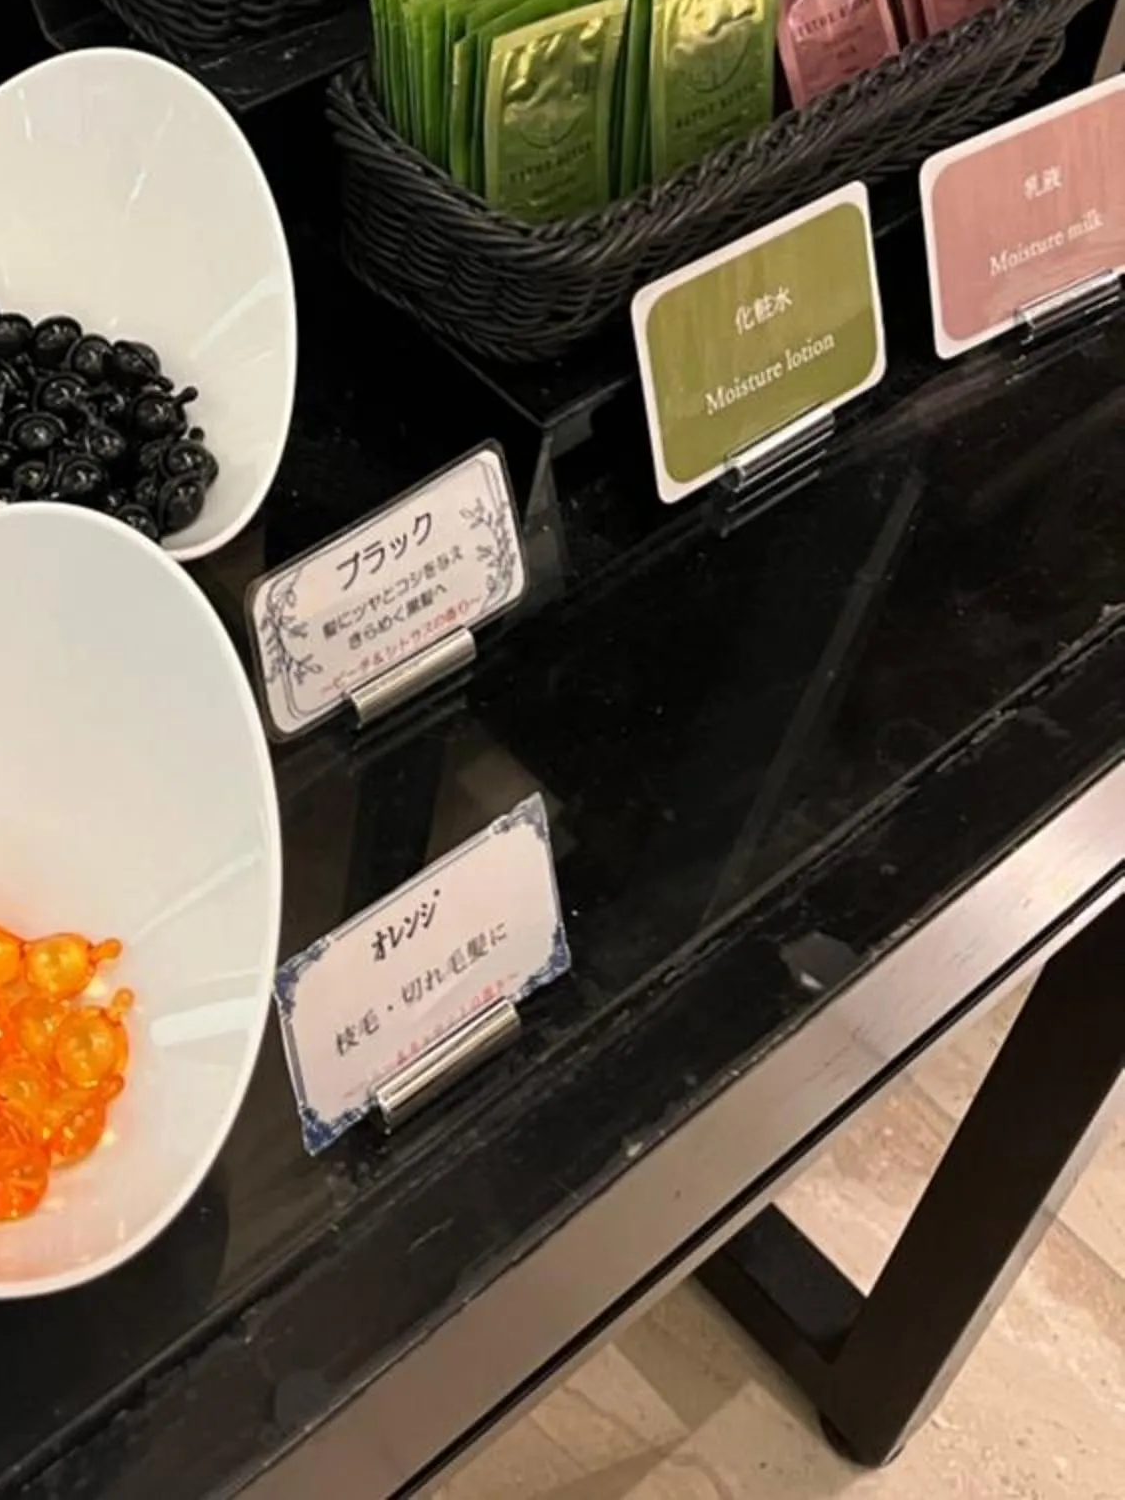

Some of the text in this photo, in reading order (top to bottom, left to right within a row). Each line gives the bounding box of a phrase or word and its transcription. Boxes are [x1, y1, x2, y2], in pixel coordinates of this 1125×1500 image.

[988, 209, 1104, 277] Moisture milk
[734, 287, 793, 335] 化粧水
[704, 332, 835, 415] Moisture lotion
[336, 512, 433, 591] ブラック
